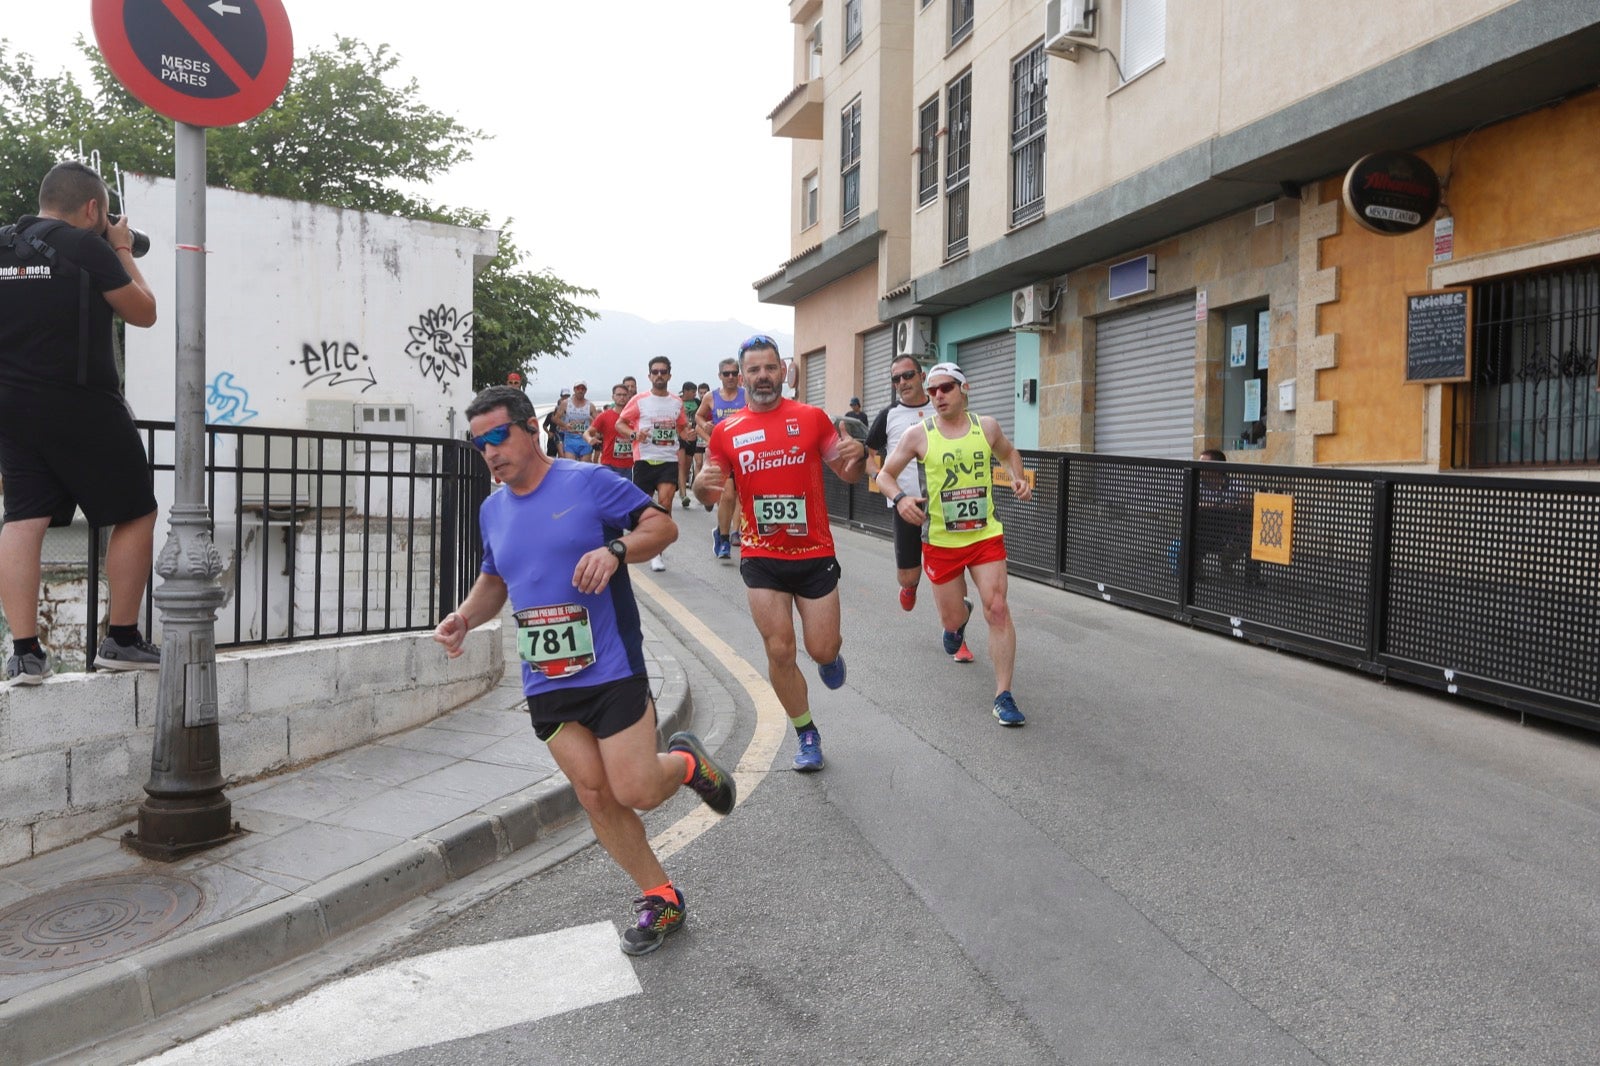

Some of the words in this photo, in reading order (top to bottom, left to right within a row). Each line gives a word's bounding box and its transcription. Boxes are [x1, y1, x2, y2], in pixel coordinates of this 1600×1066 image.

[161, 54, 211, 74] MESES
[161, 68, 207, 87] PARES
[657, 430, 673, 439] 354
[617, 444, 632, 452] 733
[738, 449, 806, 475] Polisalud
[762, 501, 798, 520] 593
[956, 500, 979, 518] 26
[539, 607, 558, 617] PREMIO
[558, 606, 565, 616] DE
[527, 625, 577, 656] 781
